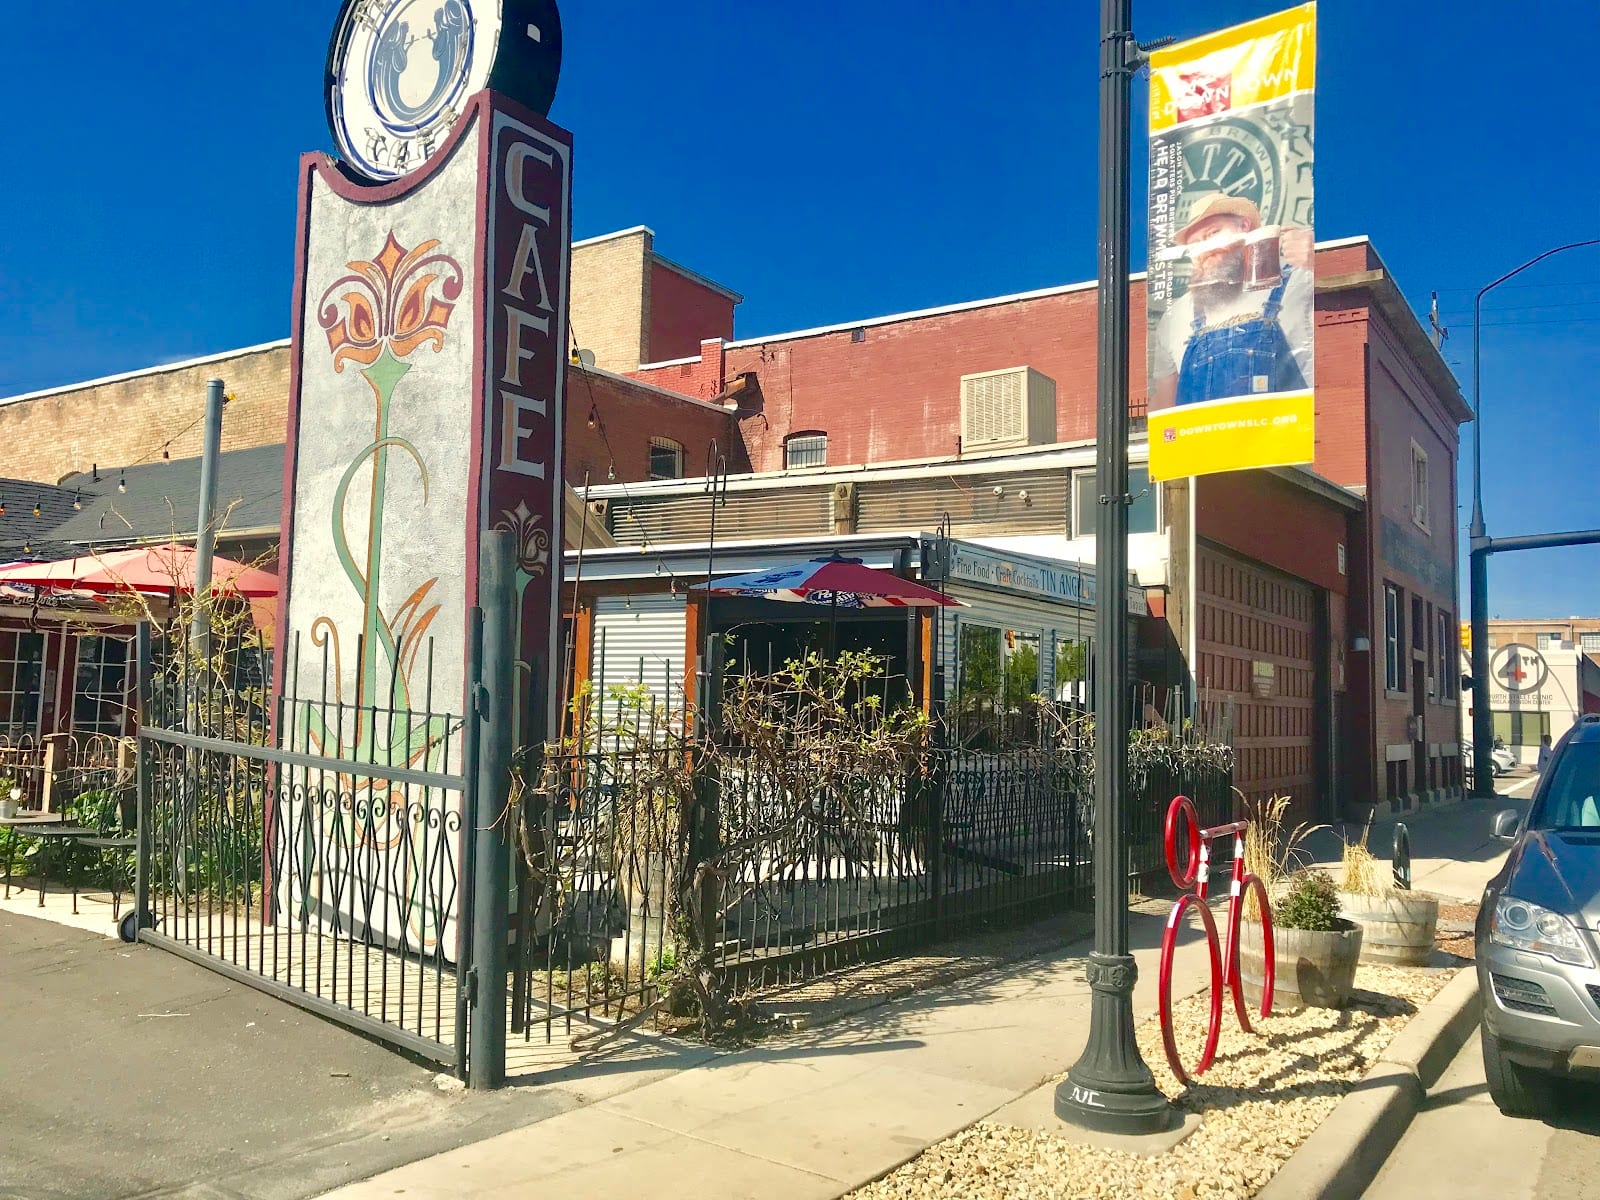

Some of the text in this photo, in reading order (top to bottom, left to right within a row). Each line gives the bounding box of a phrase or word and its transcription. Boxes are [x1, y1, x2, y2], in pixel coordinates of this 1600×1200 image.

[1164, 68, 1297, 115] DWNTOWN
[1157, 146, 1168, 189] HEAD
[496, 140, 555, 481] CAFE
[957, 557, 972, 575] Fine
[973, 561, 990, 579] Food
[1040, 569, 1056, 592] TIN
